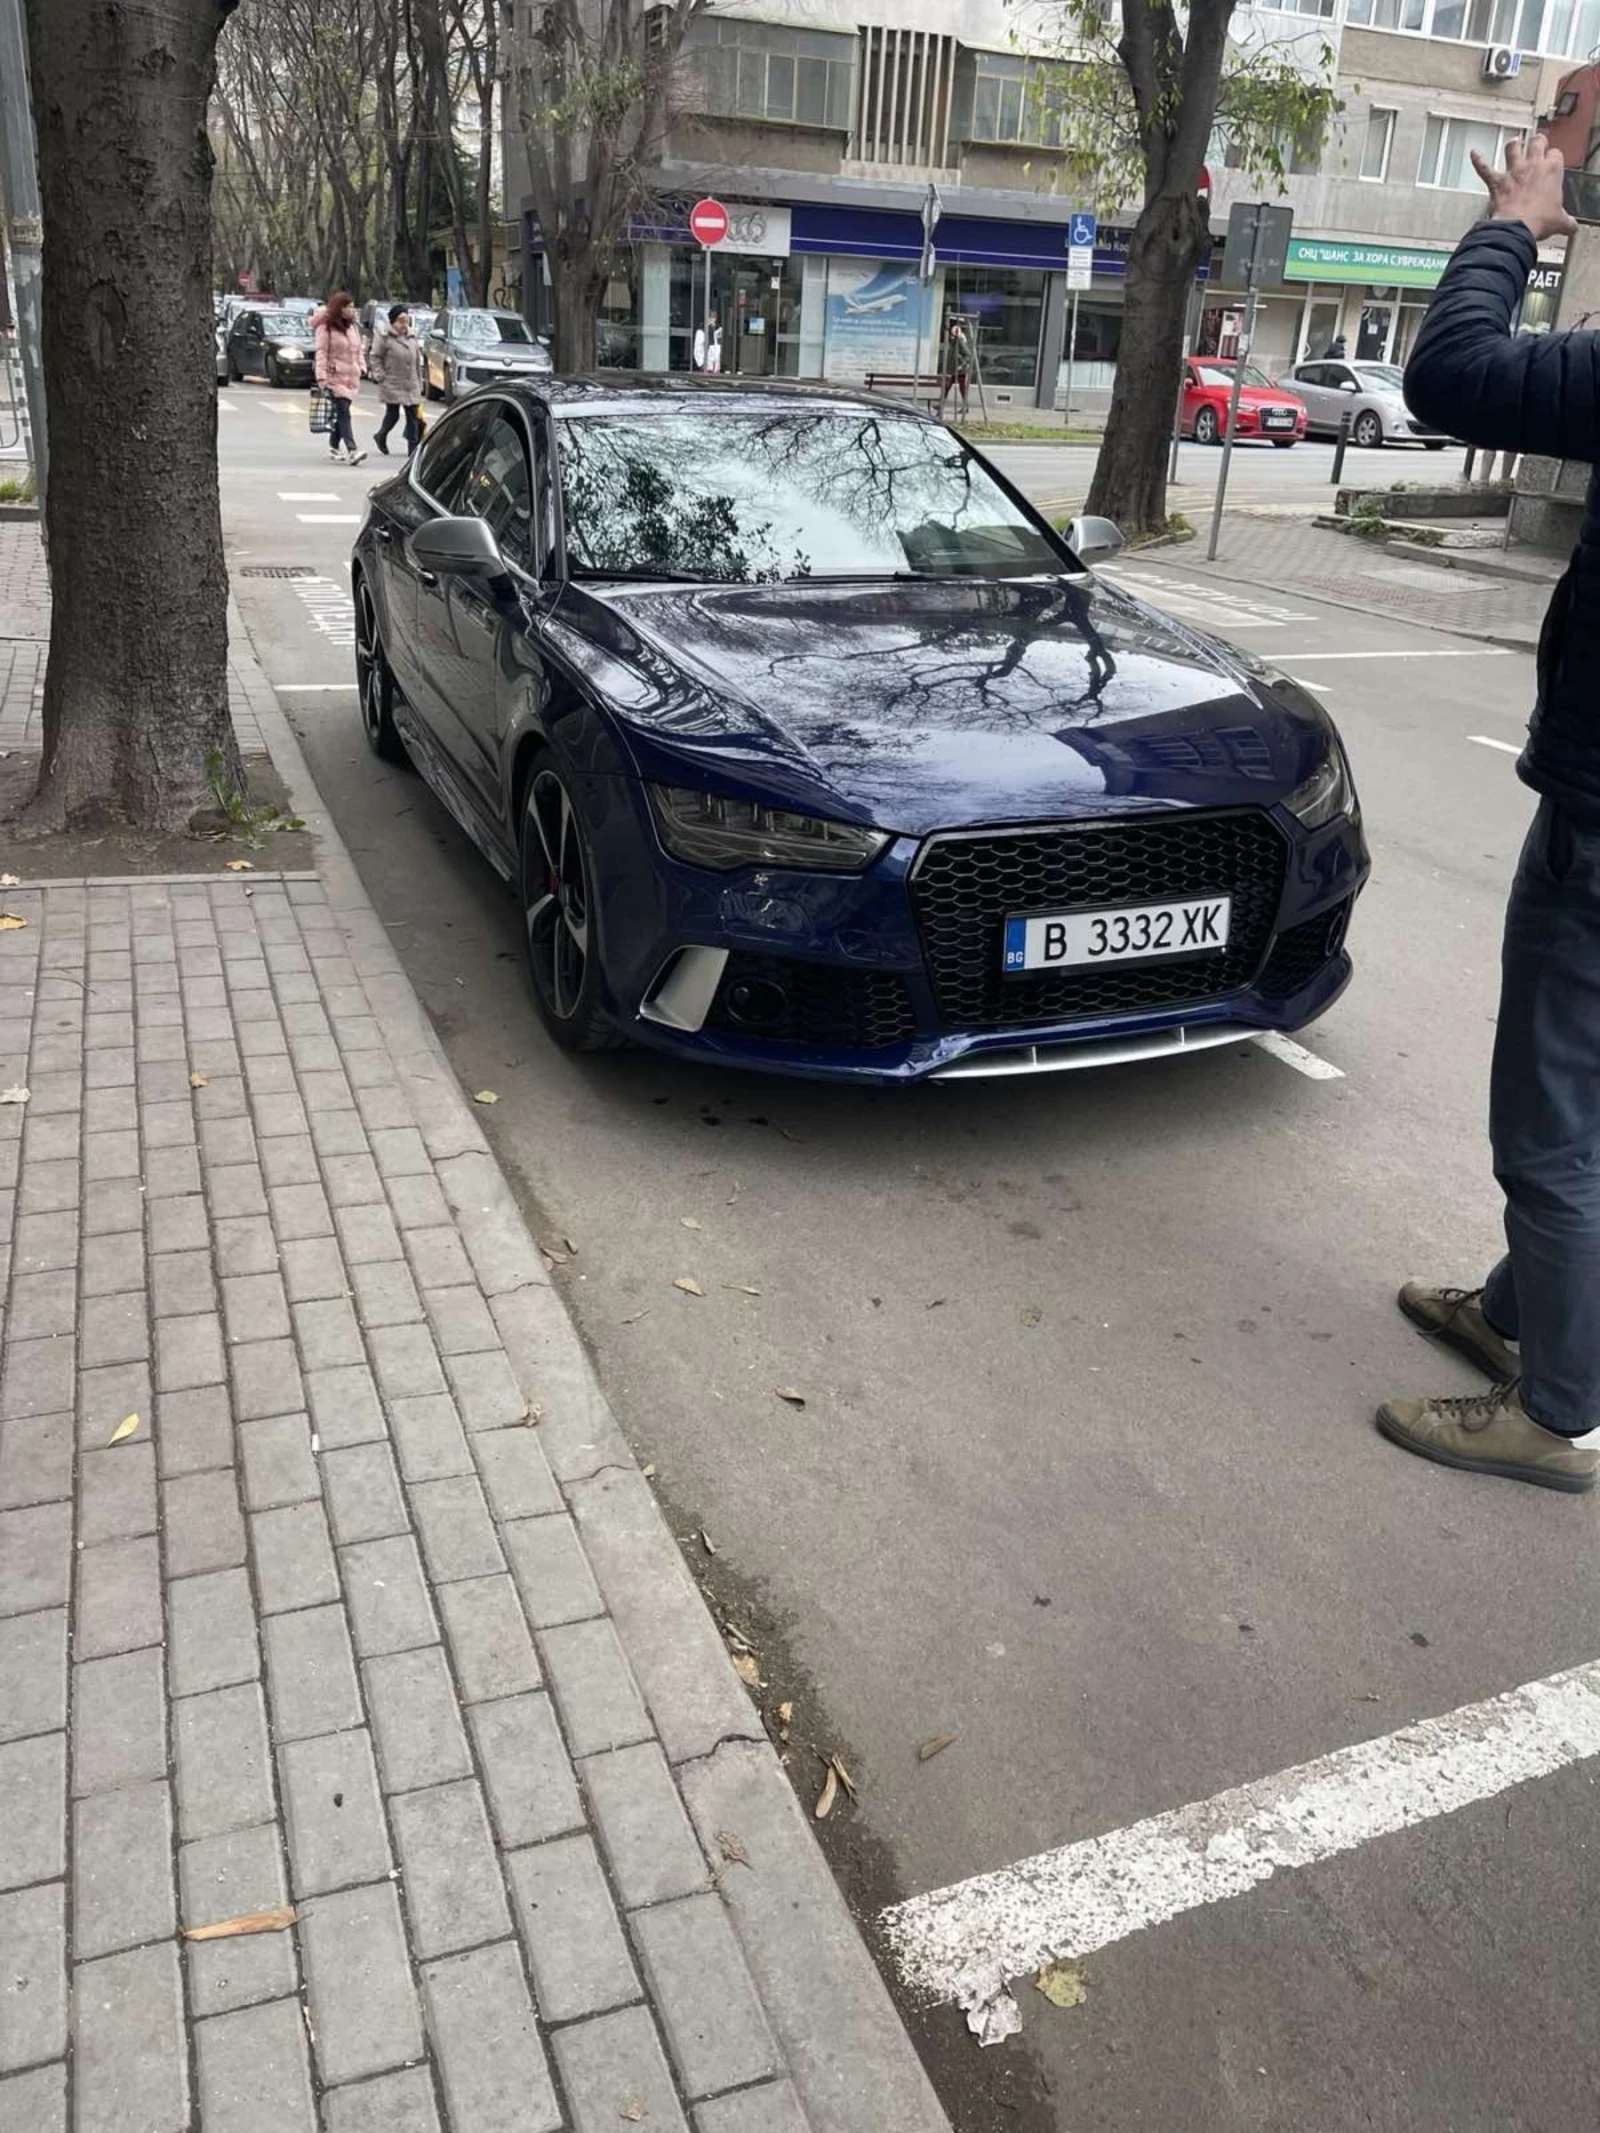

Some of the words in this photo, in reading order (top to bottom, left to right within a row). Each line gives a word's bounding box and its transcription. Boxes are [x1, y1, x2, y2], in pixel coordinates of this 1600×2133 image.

[1006, 951, 1024, 965] BG
[1043, 922, 1068, 961] B
[1087, 911, 1174, 956] 3332
[1180, 904, 1222, 946] XK
